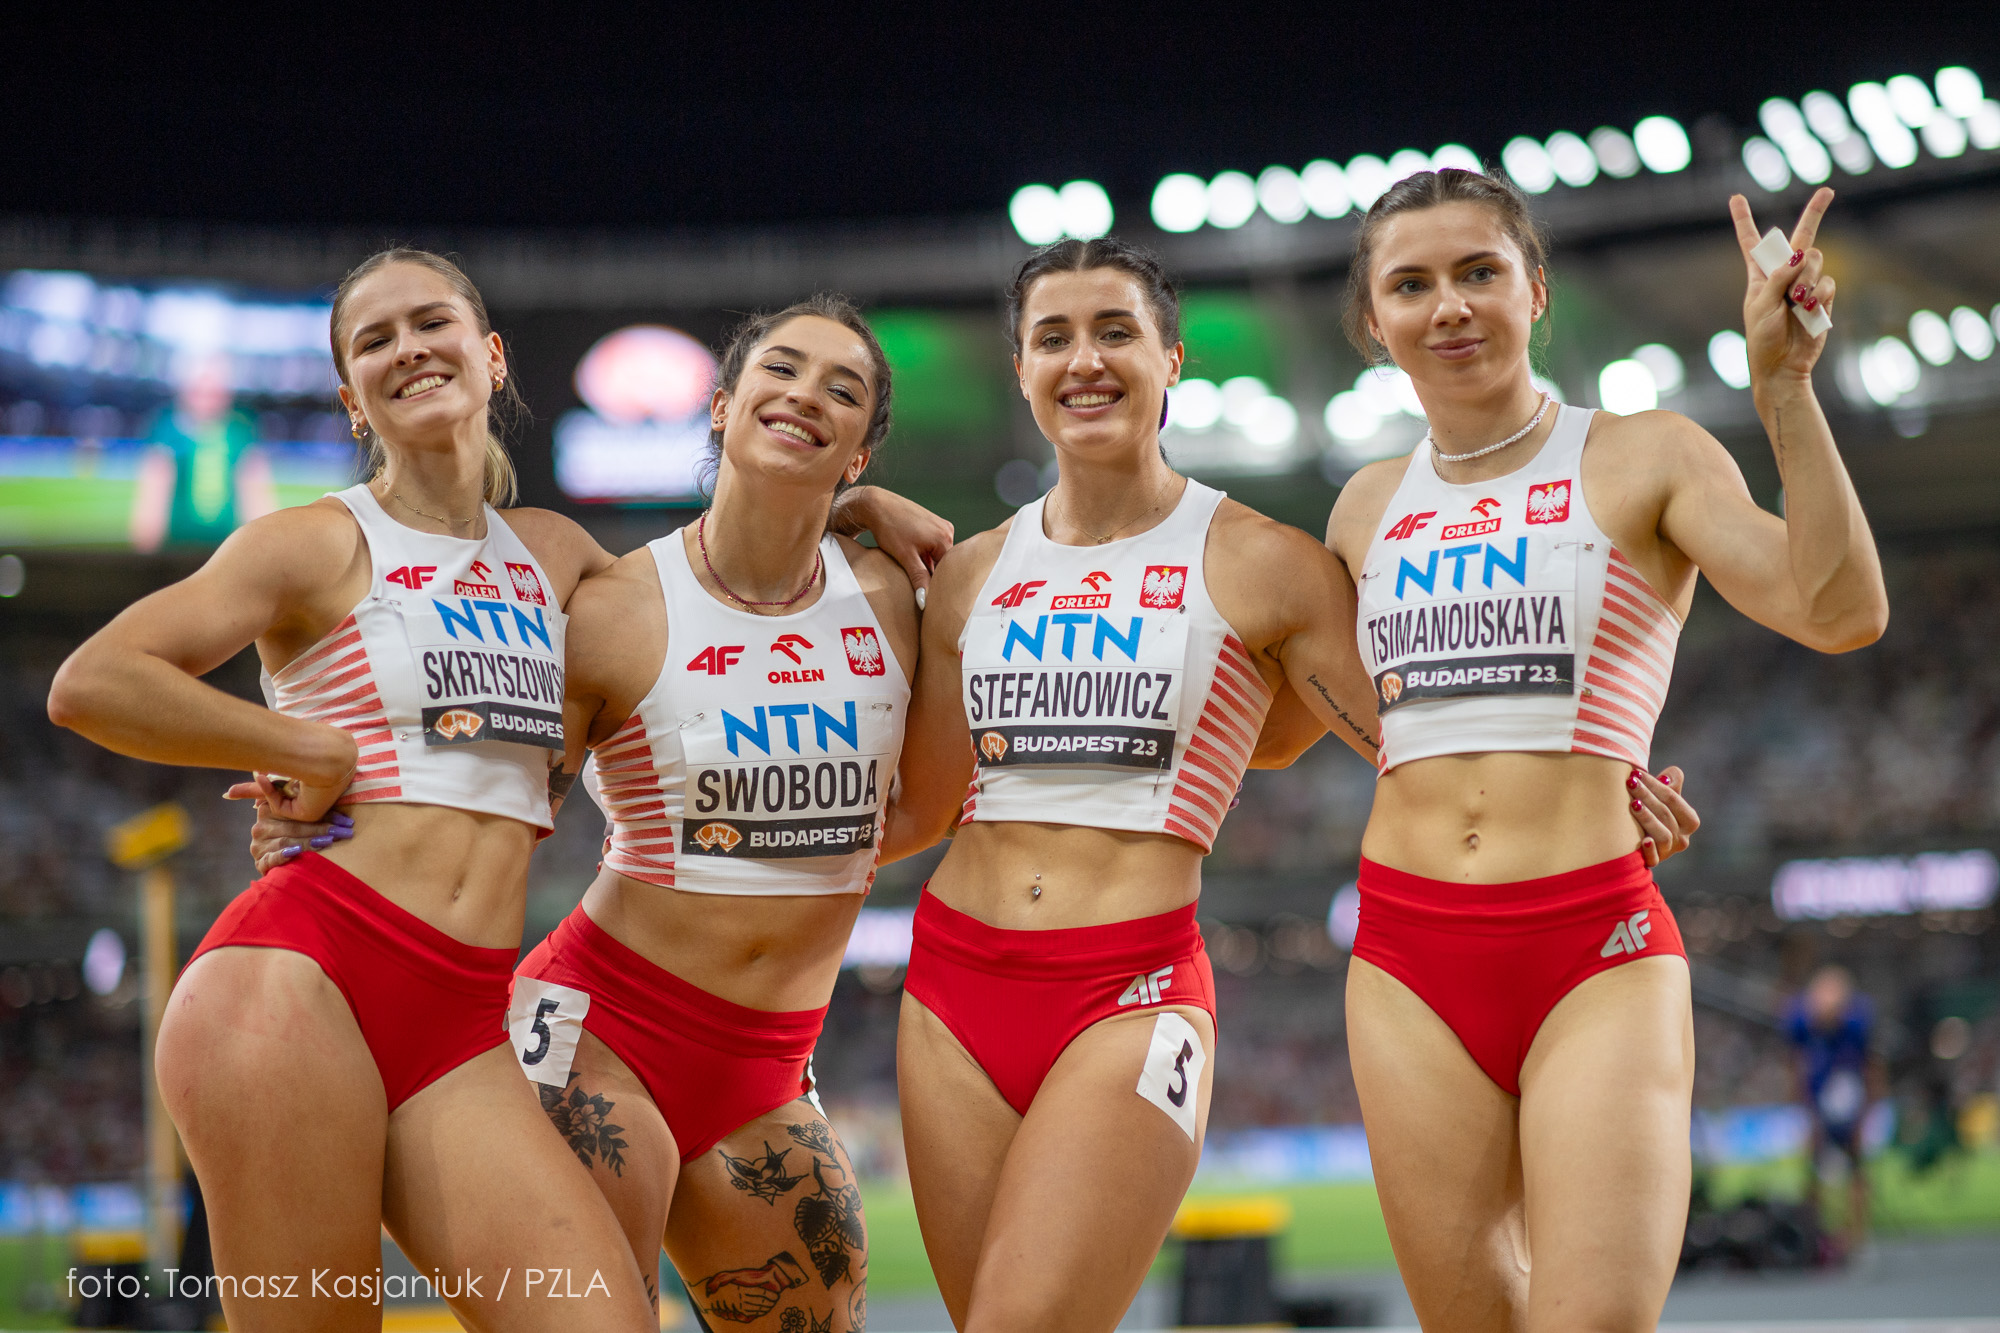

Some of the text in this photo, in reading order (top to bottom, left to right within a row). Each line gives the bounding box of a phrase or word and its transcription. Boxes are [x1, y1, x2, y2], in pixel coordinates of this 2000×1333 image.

[1384, 511, 1438, 541] 4F
[1443, 520, 1498, 537] ORLEN
[386, 565, 438, 590] 4F
[1394, 536, 1528, 601] NTN
[456, 583, 499, 599] ORLEN
[1054, 595, 1108, 609] ORLEN
[431, 598, 554, 655] NTN
[1002, 613, 1144, 663] NTN
[1368, 596, 1566, 667] TSIMANOUSKAYA
[423, 650, 565, 706] SKRZYSZOWS
[686, 645, 746, 675] 4F
[767, 669, 825, 684] ORLEN
[1406, 665, 1558, 689] BUDAPEST 23
[969, 671, 1172, 722] STEFANOWICZ
[489, 712, 564, 740] BUDAPES
[721, 700, 858, 758] NTN
[1013, 736, 1158, 757] BUDAPEST 23
[695, 759, 878, 813] SWOBODA
[750, 826, 859, 848] BUDAPEST
[1600, 908, 1651, 958] 4F
[1117, 965, 1173, 1007] 4F
[522, 998, 560, 1066] 5
[1167, 1038, 1194, 1108] 5
